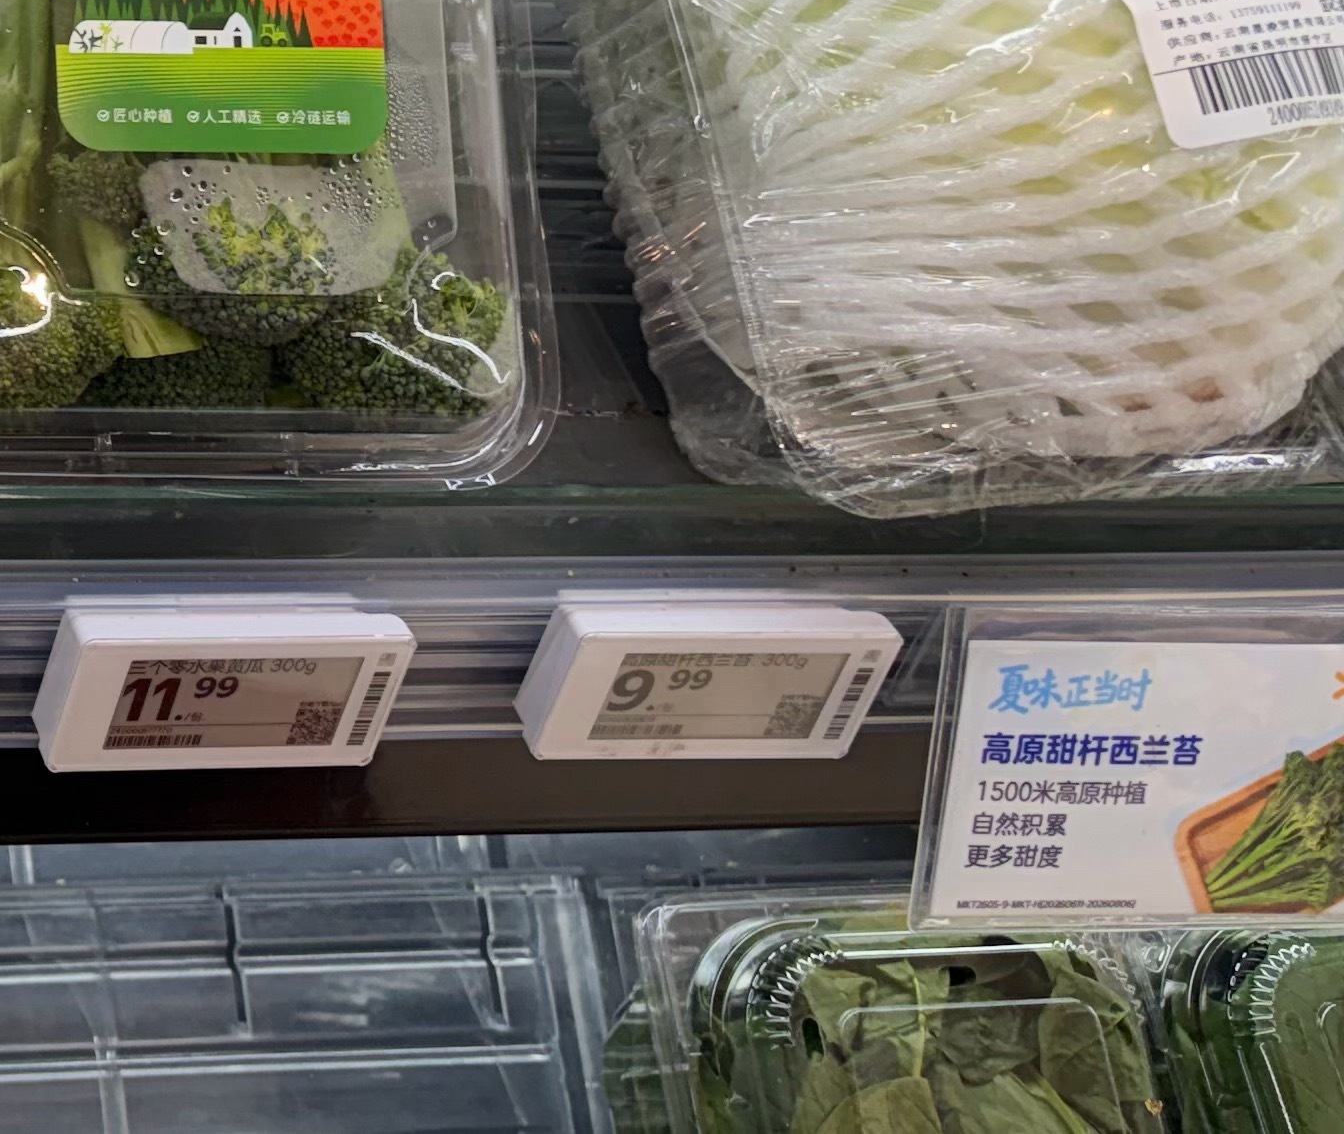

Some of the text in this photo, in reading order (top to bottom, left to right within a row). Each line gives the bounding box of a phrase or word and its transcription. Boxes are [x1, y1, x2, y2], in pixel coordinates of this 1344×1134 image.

[113, 108, 173, 124] 匠心种植
[202, 108, 262, 125] 人工精选
[291, 109, 351, 126] 冷链运输
[269, 657, 318, 675] 300g
[762, 653, 809, 670] 300g
[988, 663, 1153, 714] 夏味正当时
[981, 731, 1203, 767] 高原甜杆西兰苔
[976, 779, 1148, 805] 1500米高原种植
[971, 812, 1067, 837] 自然积累
[964, 844, 1063, 869] 更多甜度
